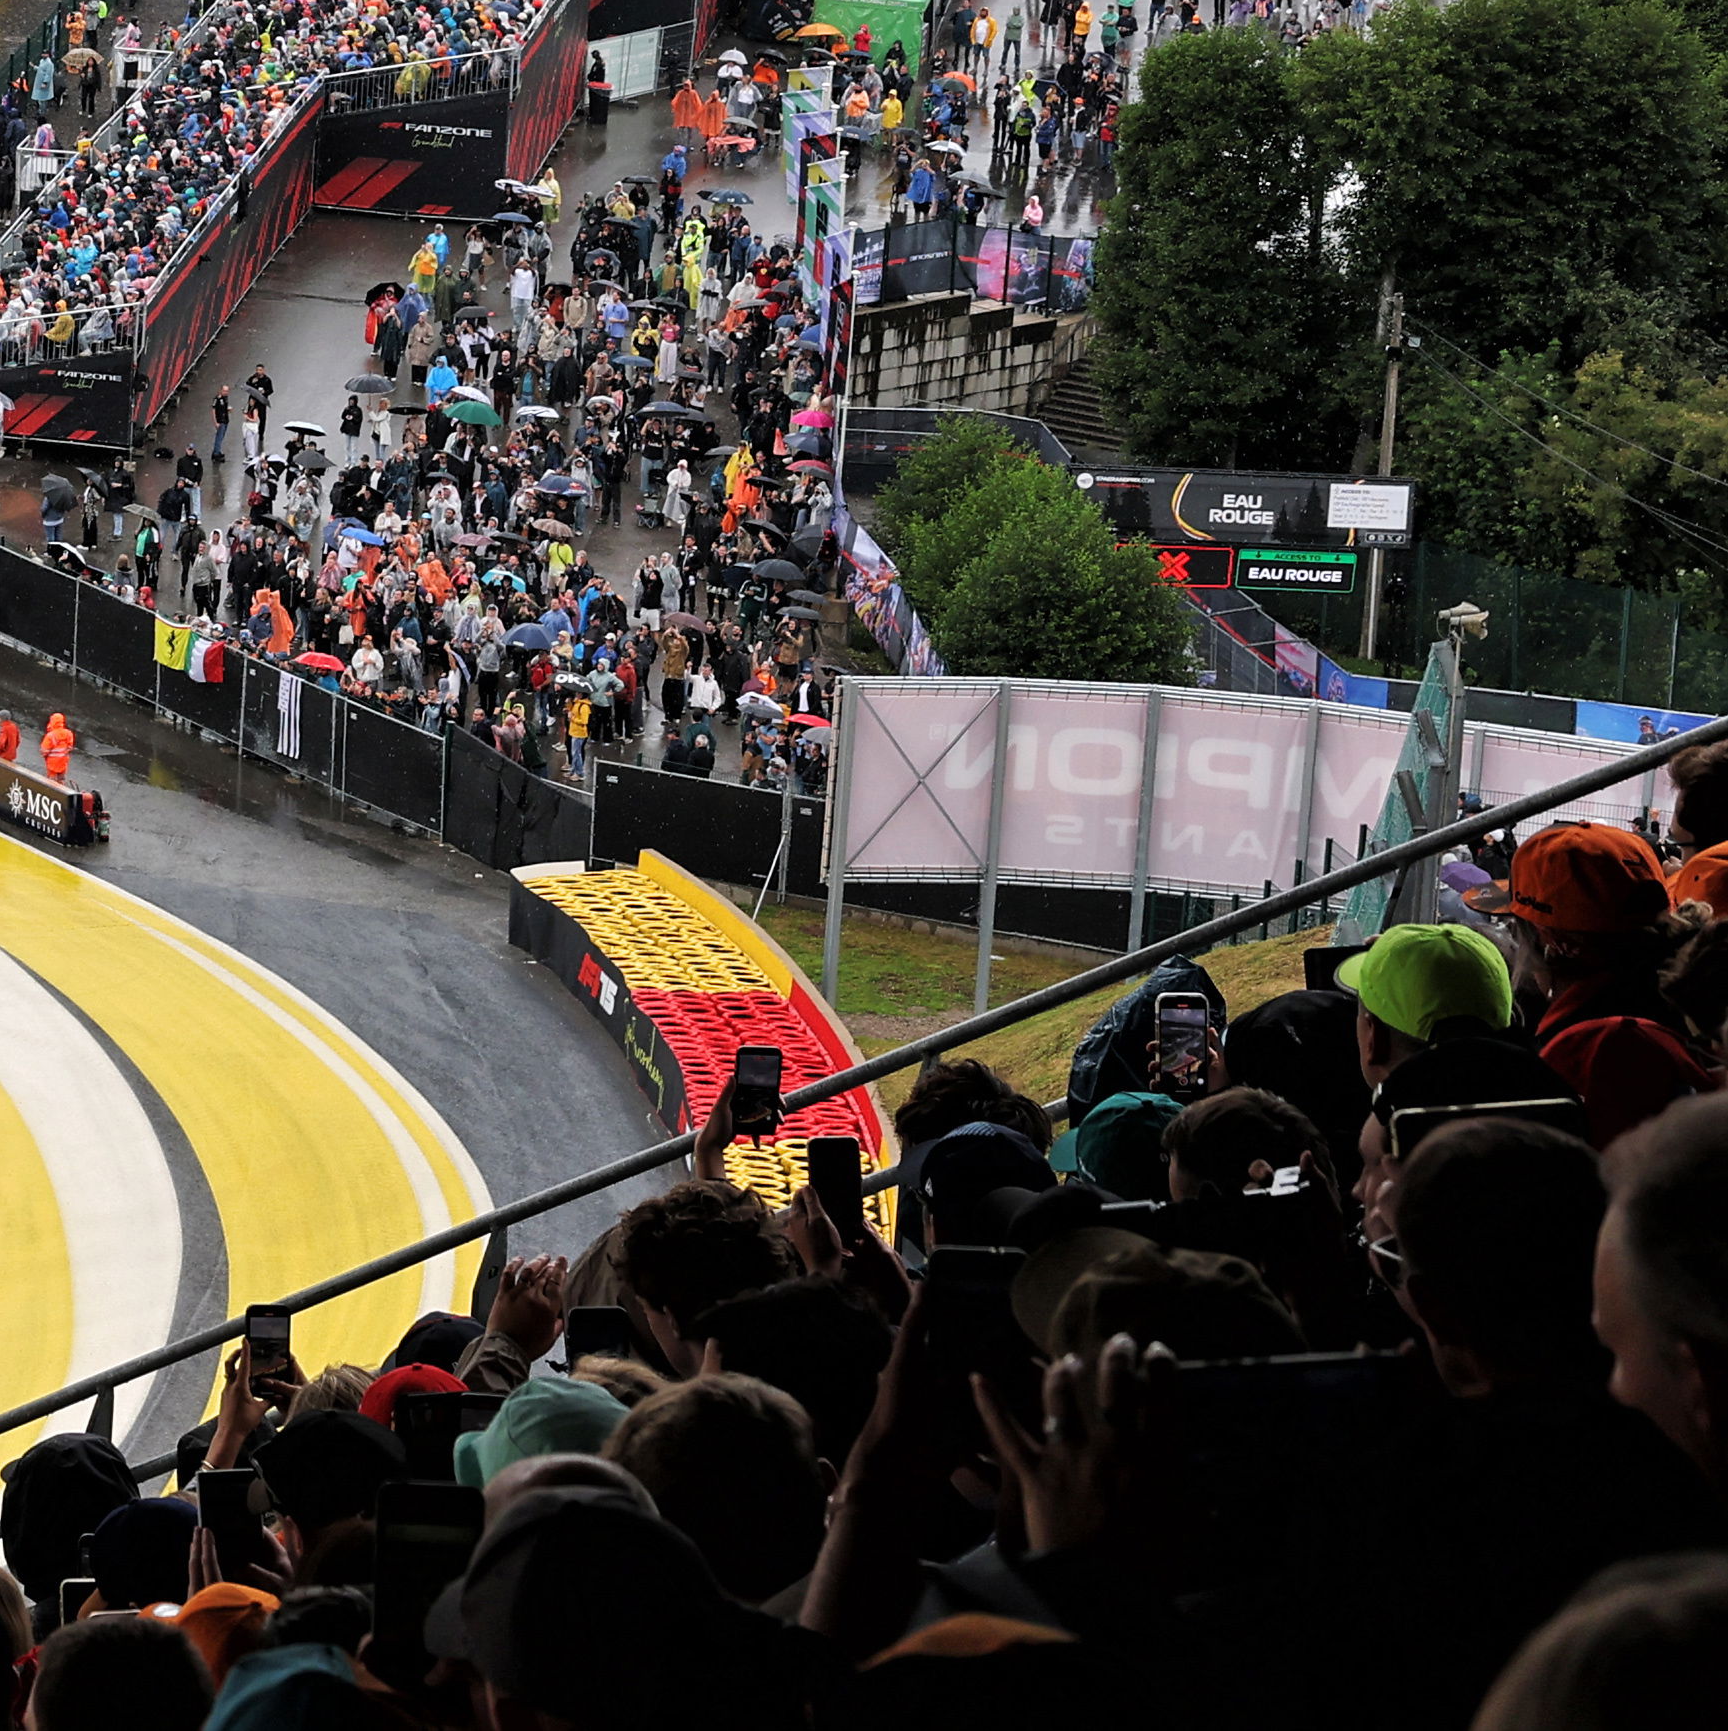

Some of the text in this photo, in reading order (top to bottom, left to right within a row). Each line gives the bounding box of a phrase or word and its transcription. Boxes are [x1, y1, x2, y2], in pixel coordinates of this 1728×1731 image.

[405, 123, 492, 138] FANZONE
[57, 370, 122, 382] FANZONE
[1223, 493, 1263, 509] EAU
[1209, 509, 1274, 525] ROUGE
[1248, 567, 1343, 584] EAU ROUGE
[25, 790, 63, 826] MSC
